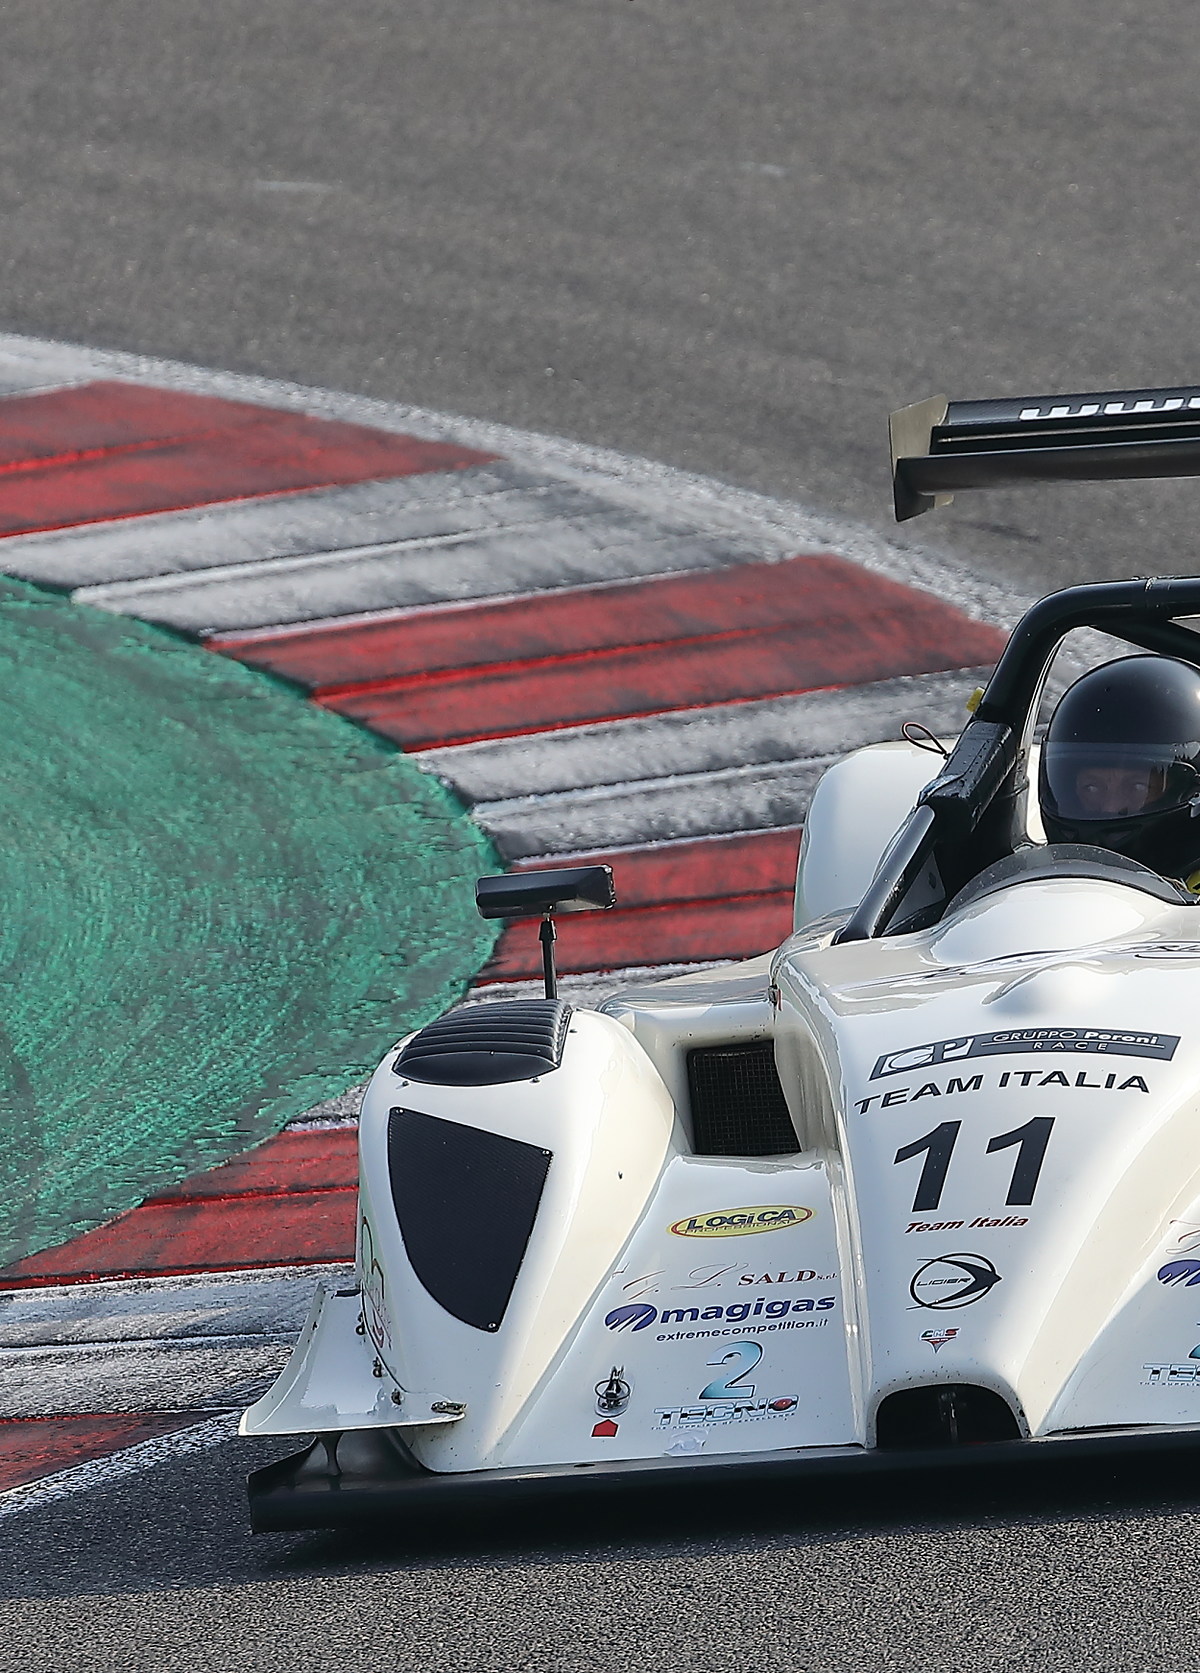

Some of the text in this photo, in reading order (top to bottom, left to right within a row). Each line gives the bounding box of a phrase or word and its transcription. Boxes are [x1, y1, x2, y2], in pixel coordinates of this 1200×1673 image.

[992, 1030, 1158, 1045] GRUPPO Peroni
[1033, 1041, 1108, 1051] RACE
[854, 1070, 1151, 1115] TEAM ITALIA
[893, 1116, 1056, 1213] 11
[904, 1215, 1030, 1234] Team Italia
[916, 1277, 971, 1287] LIGIER
[659, 1295, 836, 1325] magigas
[656, 1318, 829, 1342] extremecompetition.it
[920, 1327, 960, 1338] CMS
[699, 1340, 764, 1399] 2
[653, 1394, 799, 1426] TECNO
